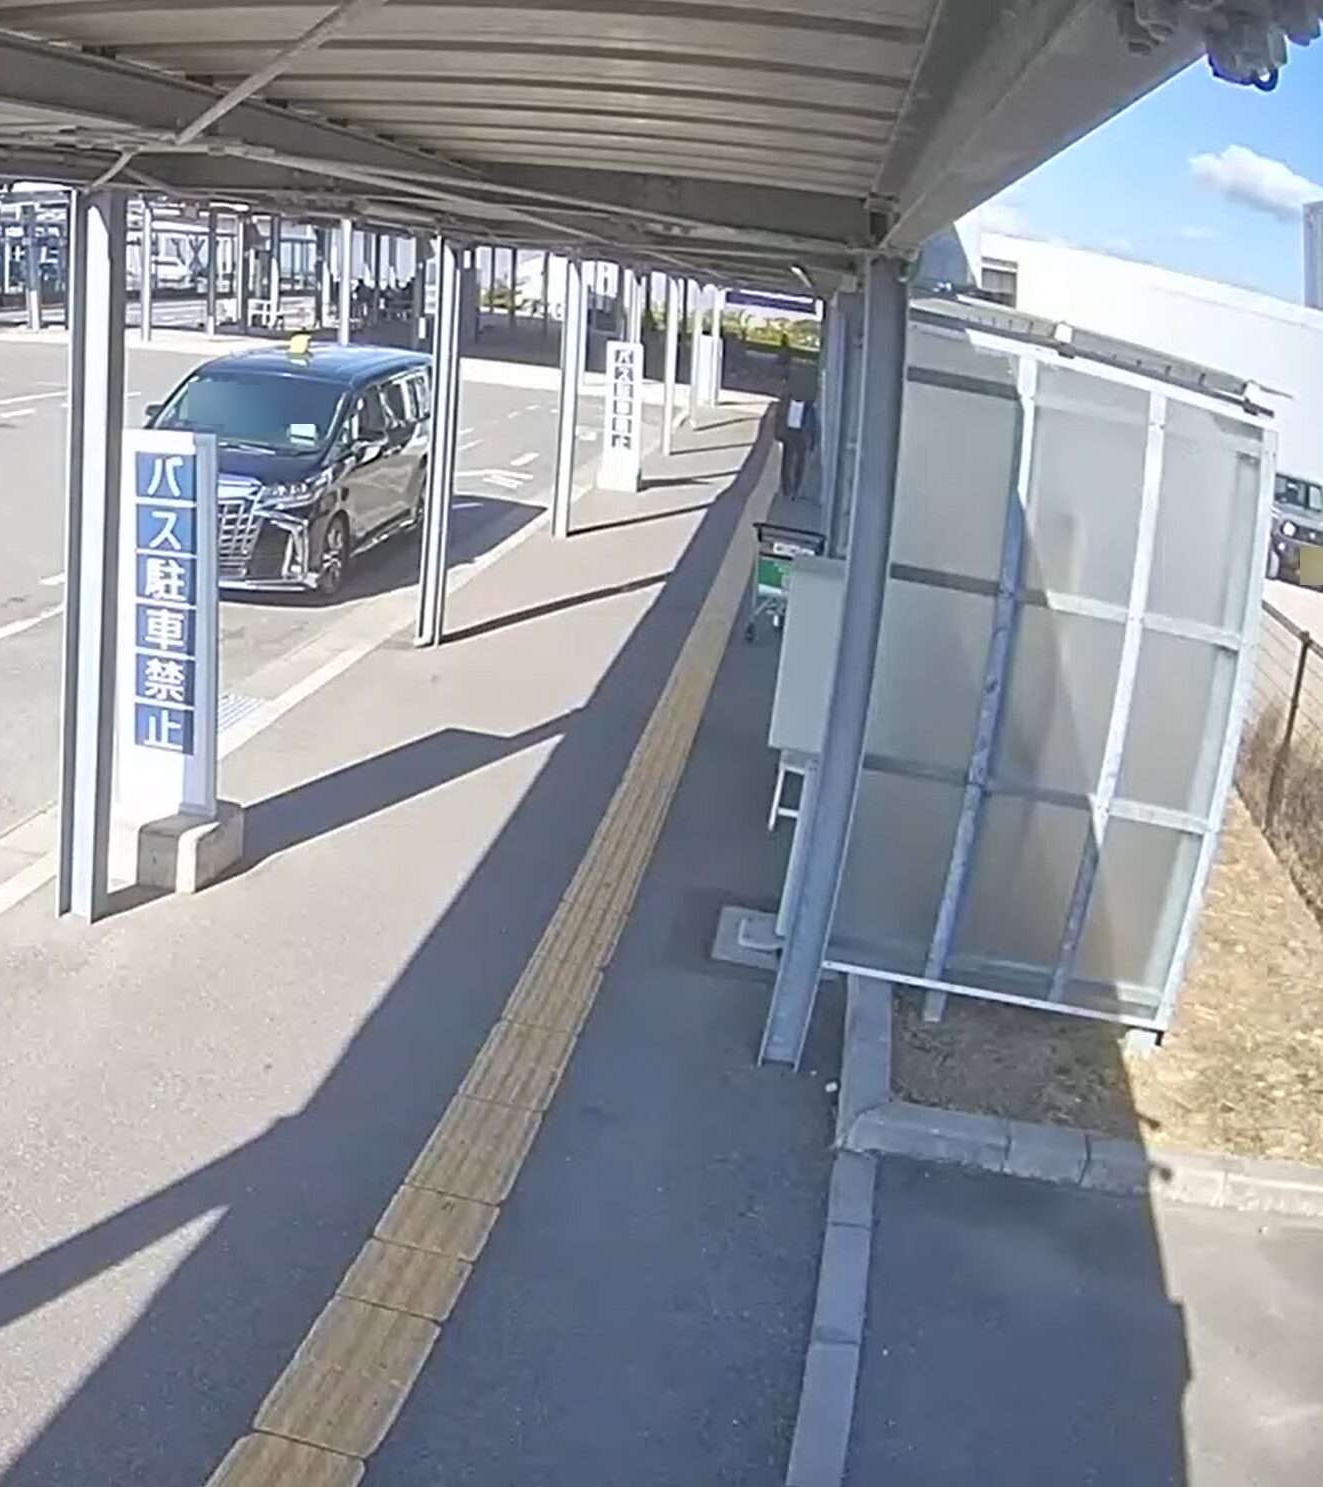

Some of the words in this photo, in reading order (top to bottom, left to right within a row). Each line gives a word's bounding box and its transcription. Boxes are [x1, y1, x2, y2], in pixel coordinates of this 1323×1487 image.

[144, 455, 185, 750] バス駐車禁止
